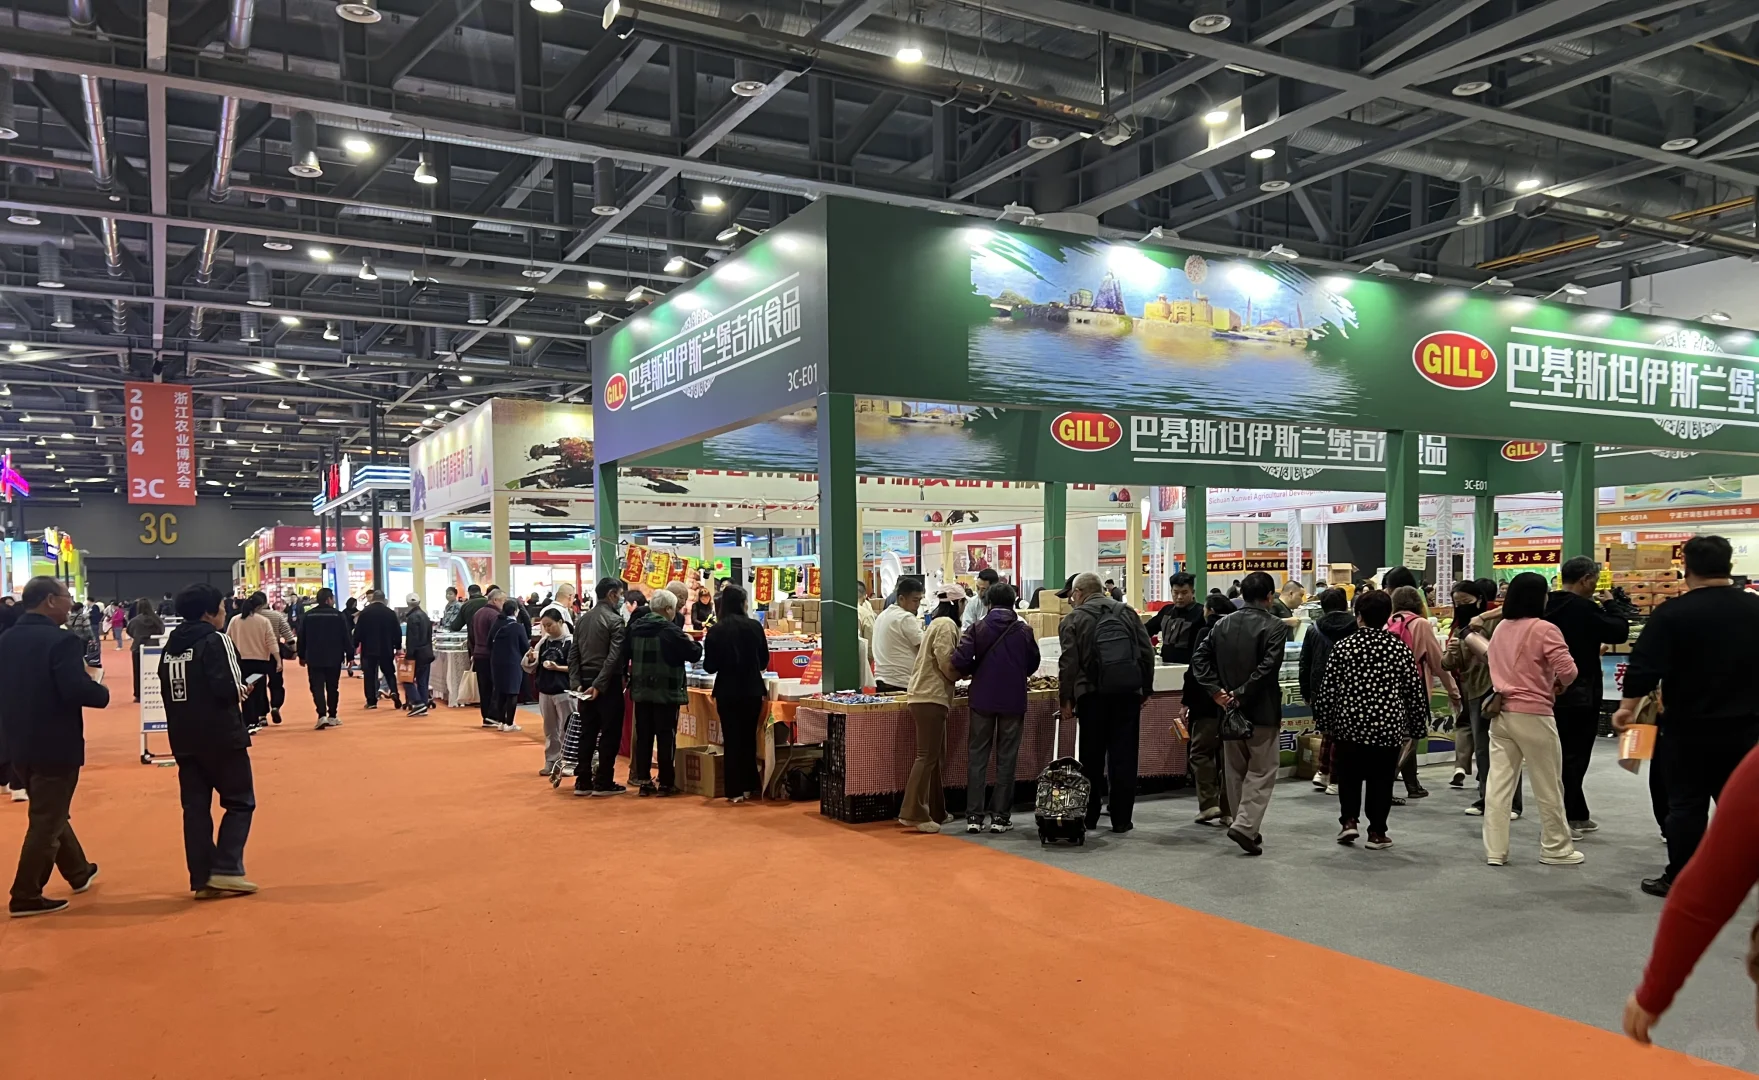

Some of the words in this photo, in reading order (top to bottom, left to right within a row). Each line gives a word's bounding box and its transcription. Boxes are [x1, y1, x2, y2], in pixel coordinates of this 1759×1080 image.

[629, 285, 801, 402] 巴基斯坦伊斯兰堡吉尔食品
[1422, 342, 1484, 379] GILL
[606, 381, 624, 400] GILL
[787, 363, 818, 392] 3C-E01
[1506, 341, 1759, 414] 巴基斯坦伊斯兰堡
[130, 388, 145, 456] 2024
[1058, 418, 1111, 444] GILL
[174, 391, 192, 489] 浙江农业博览会
[1130, 415, 1447, 467] 巴基斯坦伊斯兰堡吉品
[1506, 442, 1540, 458] GILL
[132, 478, 166, 499] 3C
[1464, 479, 1488, 491] 3C-E01
[139, 512, 178, 544] 3C
